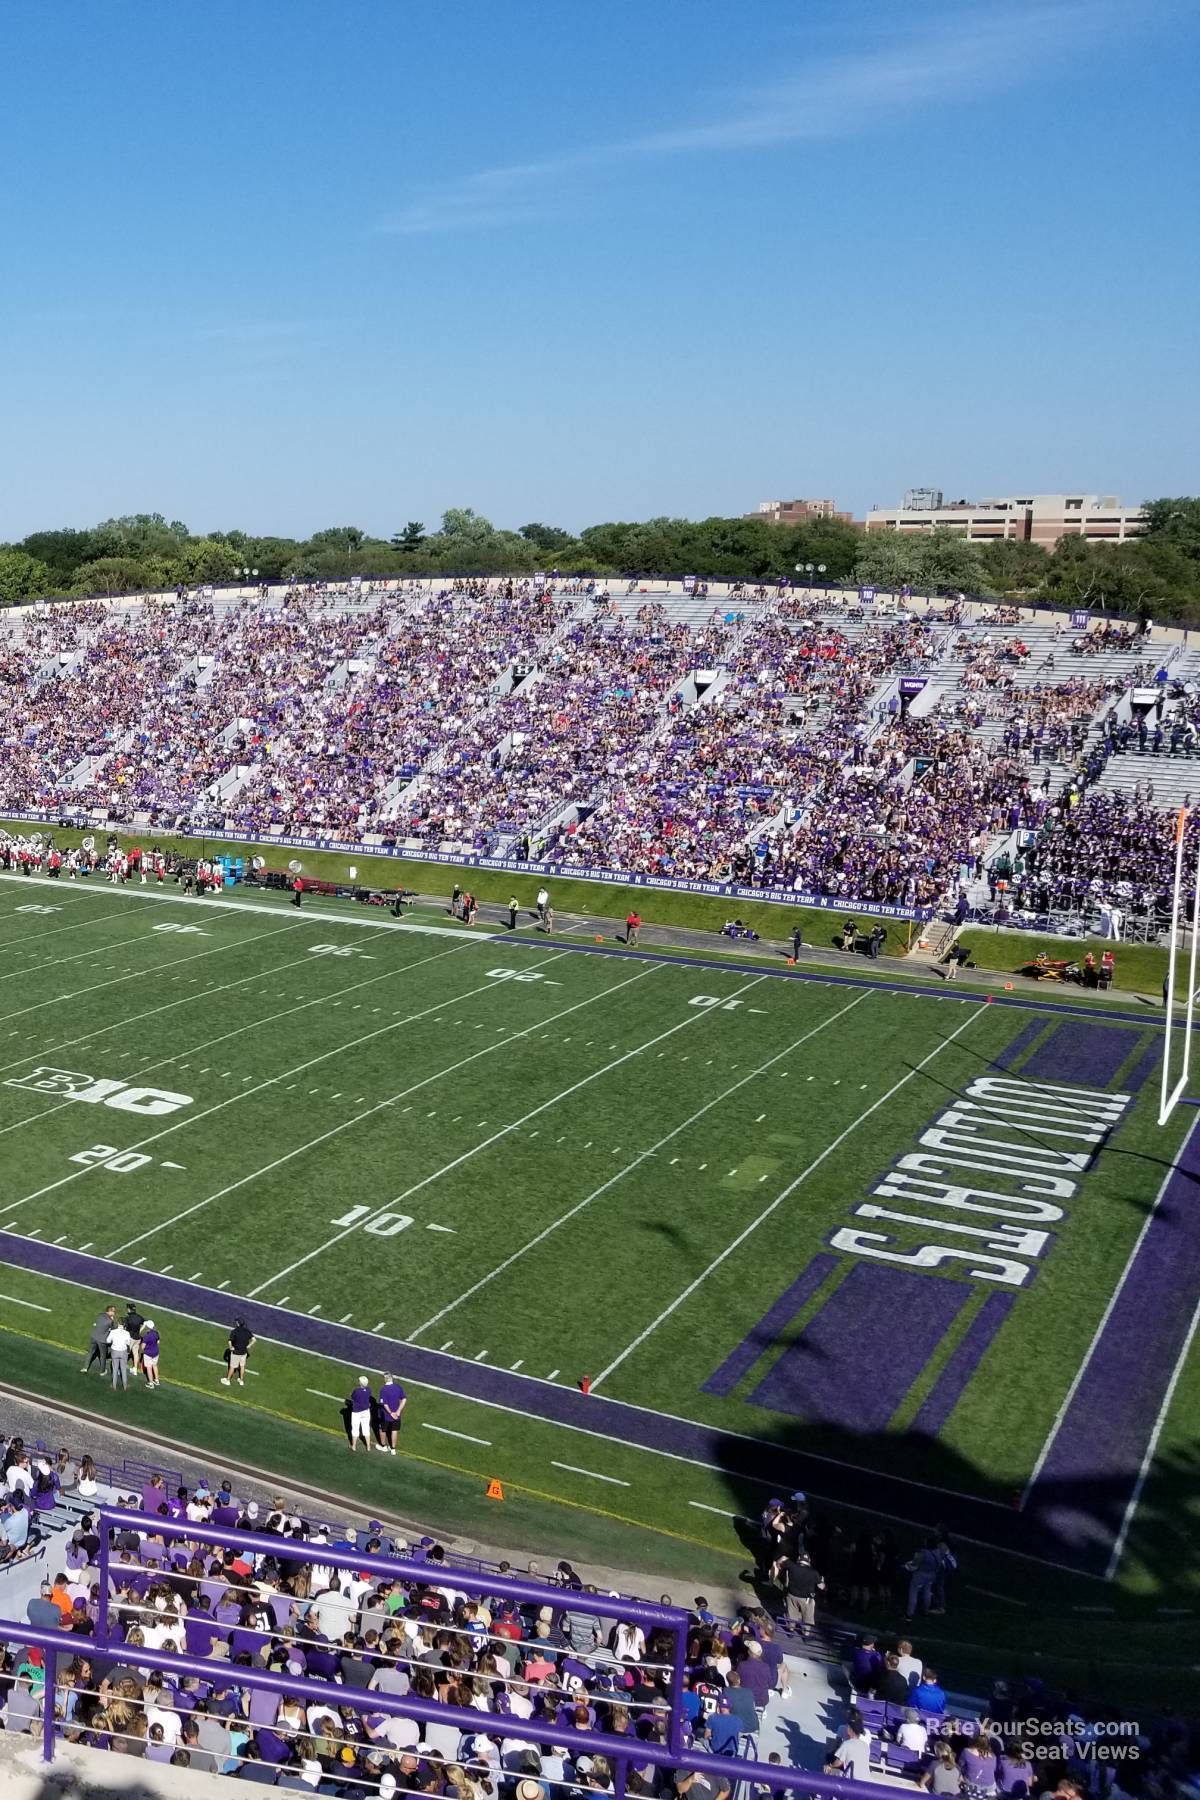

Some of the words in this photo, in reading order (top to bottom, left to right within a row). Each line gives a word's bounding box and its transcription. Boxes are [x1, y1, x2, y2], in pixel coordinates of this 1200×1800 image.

[1076, 615, 1085, 623] 111
[402, 850, 428, 859] CHICAGO'S
[479, 859, 506, 868] CHICAGO'S
[560, 868, 589, 876] CHICAGO'S
[647, 878, 677, 887] CHICAGO'S
[703, 884, 720, 892] TEAM
[737, 888, 769, 898] CHICAGO'S
[797, 895, 815, 904] TEAM
[14, 904, 63, 914] 50
[821, 898, 827, 907] N
[834, 900, 868, 910] CHICAGO'S
[869, 904, 880, 912] BIG
[882, 906, 895, 914] TEN
[896, 908, 915, 917] TEAM
[152, 923, 203, 933] 40
[307, 943, 365, 957] 30
[485, 968, 544, 982] 20
[687, 995, 744, 1010] 10
[68, 1144, 152, 1172] 20
[830, 1077, 1131, 1285] WILDCATS
[330, 1204, 415, 1235] 10
[172, 1508, 180, 1518] 7
[255, 1612, 270, 1630] 51
[346, 1723, 359, 1734] 51
